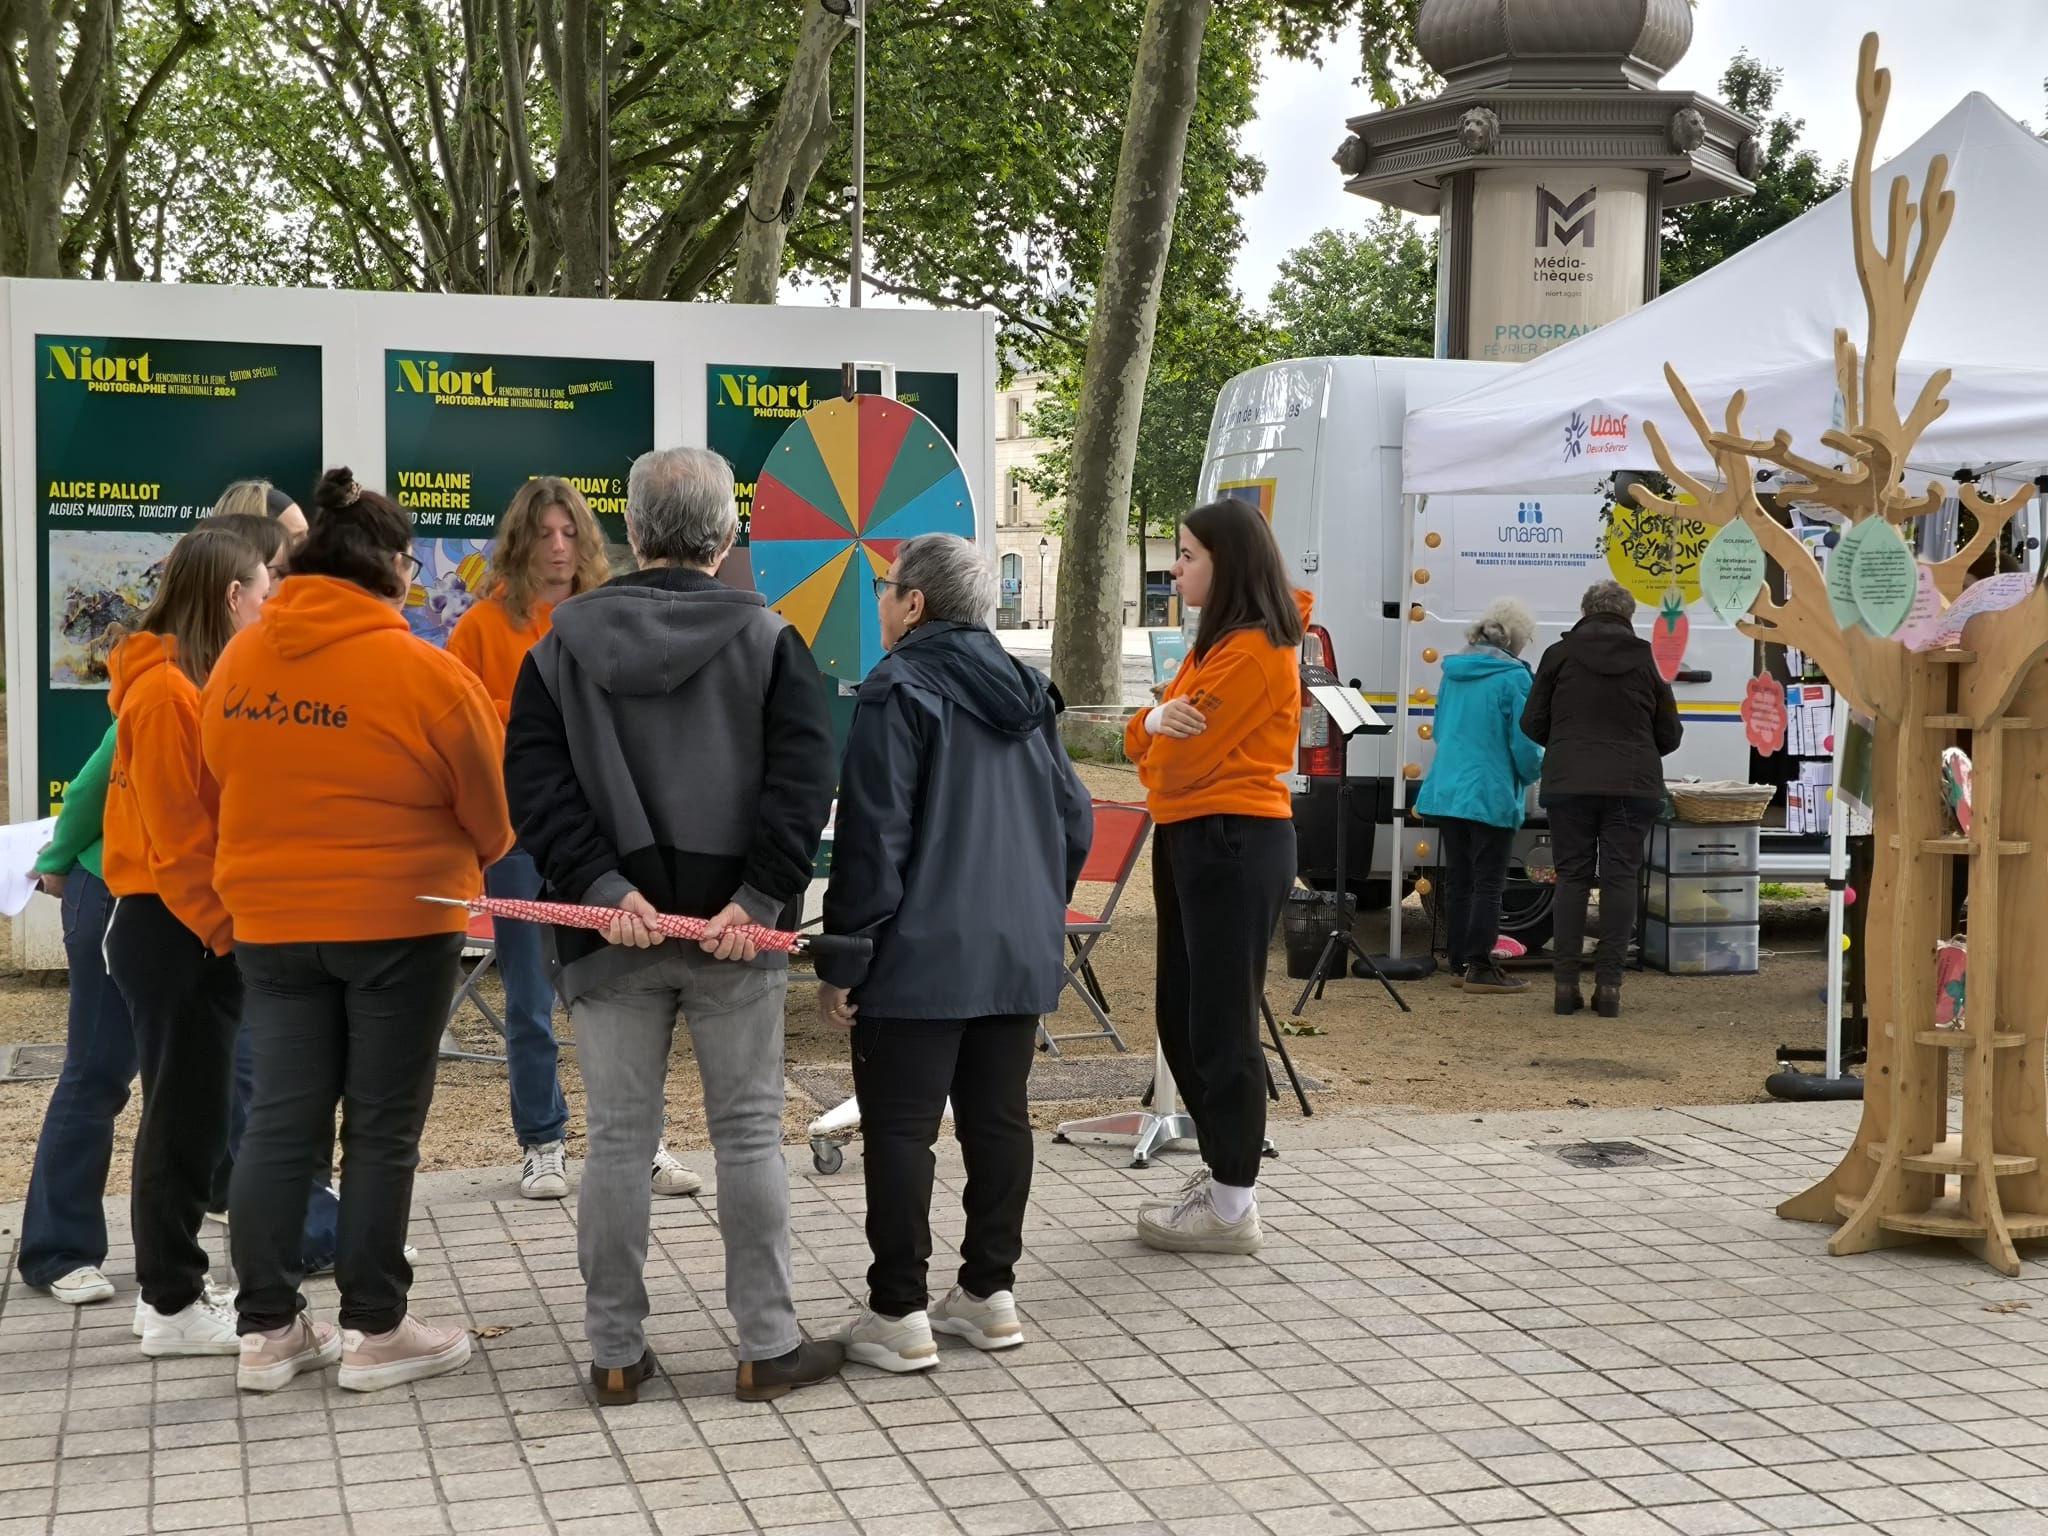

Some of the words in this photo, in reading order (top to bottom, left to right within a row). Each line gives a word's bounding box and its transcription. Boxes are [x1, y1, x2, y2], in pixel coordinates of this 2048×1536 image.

[1534, 256, 1586, 268] Média-
[1533, 270, 1593, 284] thèques
[46, 346, 154, 383] Niort
[155, 373, 192, 384] RENCONTRES
[192, 374, 200, 385] DE
[201, 375, 209, 385] LA
[209, 376, 226, 385] JEUNE
[395, 360, 497, 396] Niort
[88, 382, 167, 394] PHOTOGRAPHIE
[167, 385, 213, 396] INTERNATIONALE
[214, 387, 236, 397] 2024
[498, 386, 533, 398] RENCONTRES
[533, 388, 541, 398] DE
[541, 389, 549, 398] LA
[549, 389, 565, 399] JEUNE
[716, 374, 813, 408] Niort
[435, 395, 509, 407] PHOTOGRAPHIE
[510, 398, 553, 409] INTERNATIONALE
[553, 400, 575, 410] 2024
[398, 471, 471, 489] VIOLAINE
[49, 481, 95, 498] ALICE
[99, 483, 160, 500] PALLOT
[398, 488, 470, 508] CARRÈRE
[49, 503, 85, 516] ALGUES
[86, 504, 136, 518] MAUDITES,
[139, 505, 178, 518] TOXICITY
[180, 505, 193, 519] OF
[420, 512, 443, 525] SAVE
[445, 513, 462, 526] THE
[463, 514, 495, 526] CREAM
[293, 700, 348, 729] Cité
